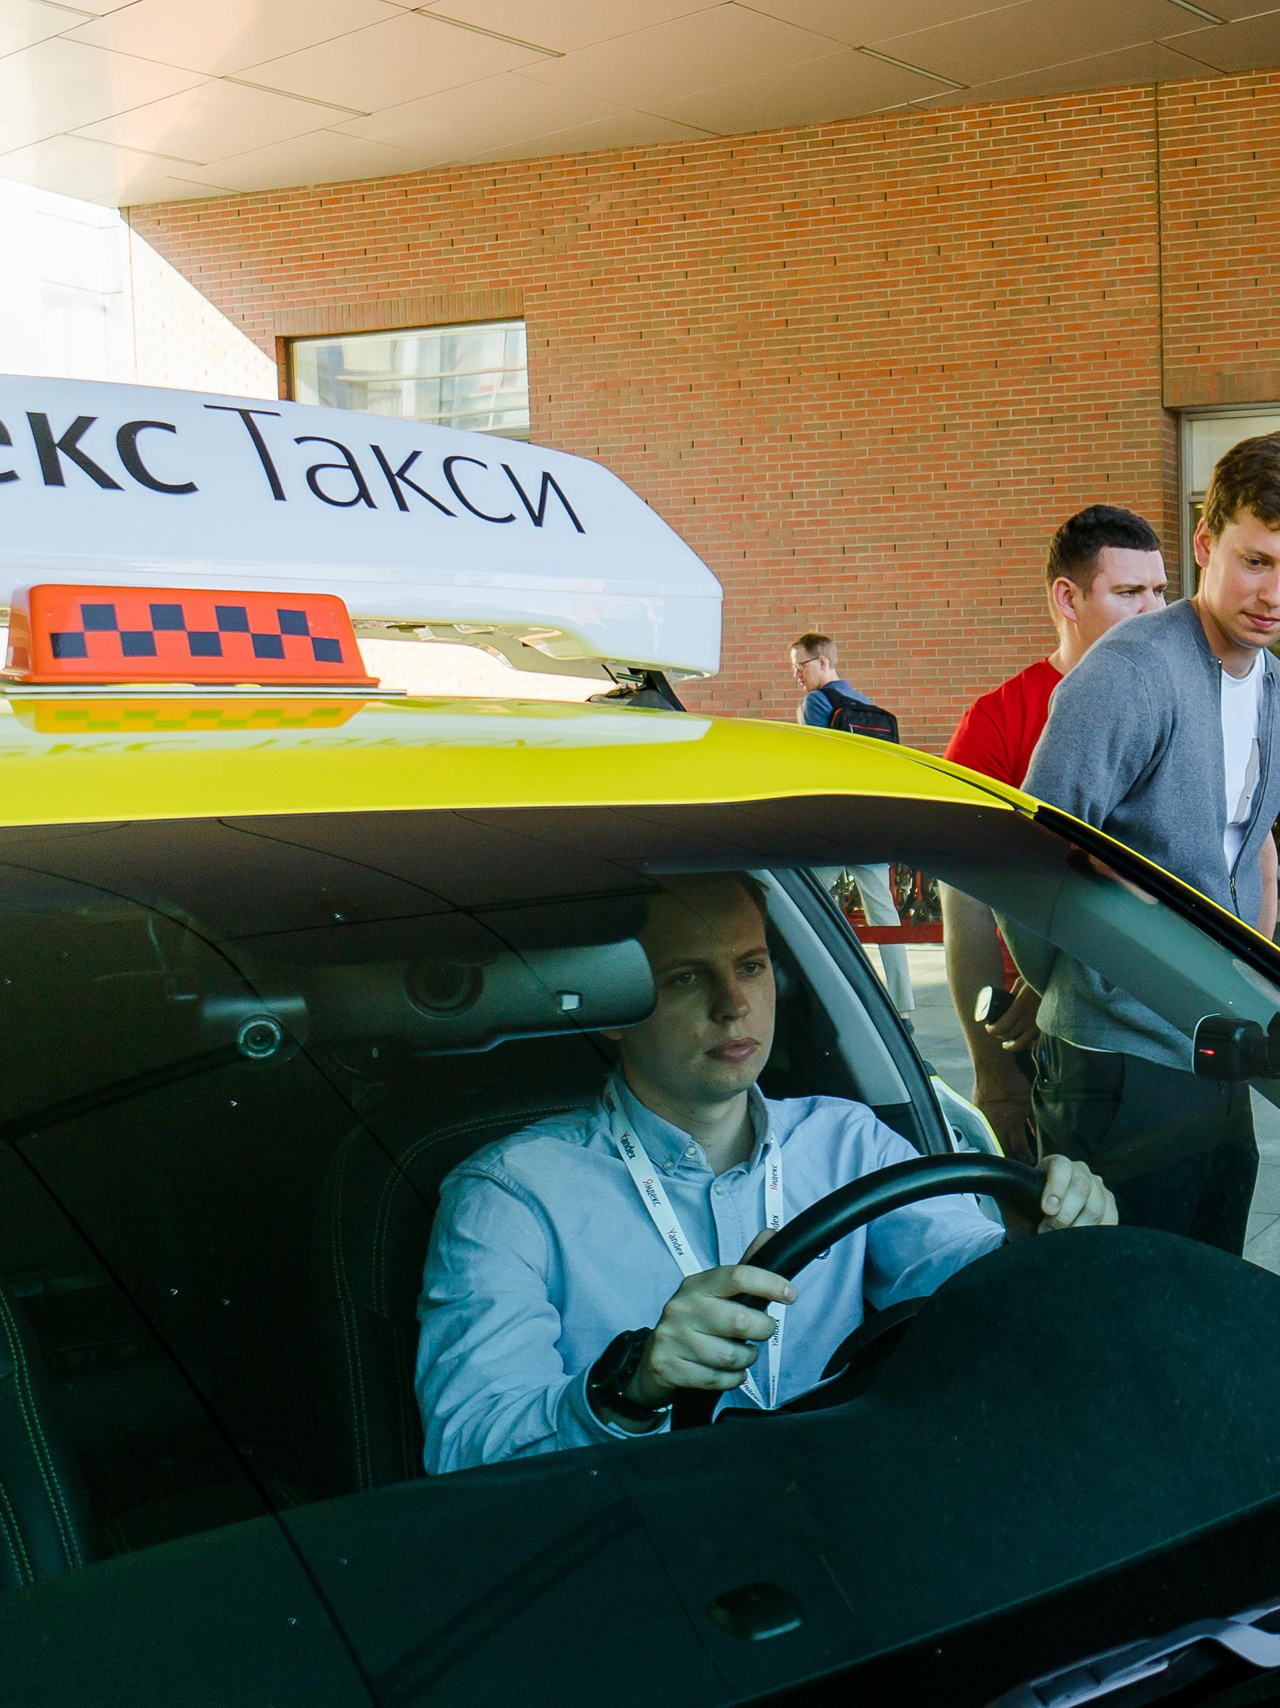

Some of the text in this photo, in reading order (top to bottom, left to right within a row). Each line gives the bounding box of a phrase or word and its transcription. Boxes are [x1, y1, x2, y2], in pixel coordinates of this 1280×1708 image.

[203, 403, 586, 534] Такси
[620, 1131, 636, 1159] Yandex
[770, 1163, 779, 1191] Яндекс
[642, 1178, 661, 1207] Яндекс
[770, 1214, 780, 1231] dex
[667, 1228, 685, 1256] Yandex
